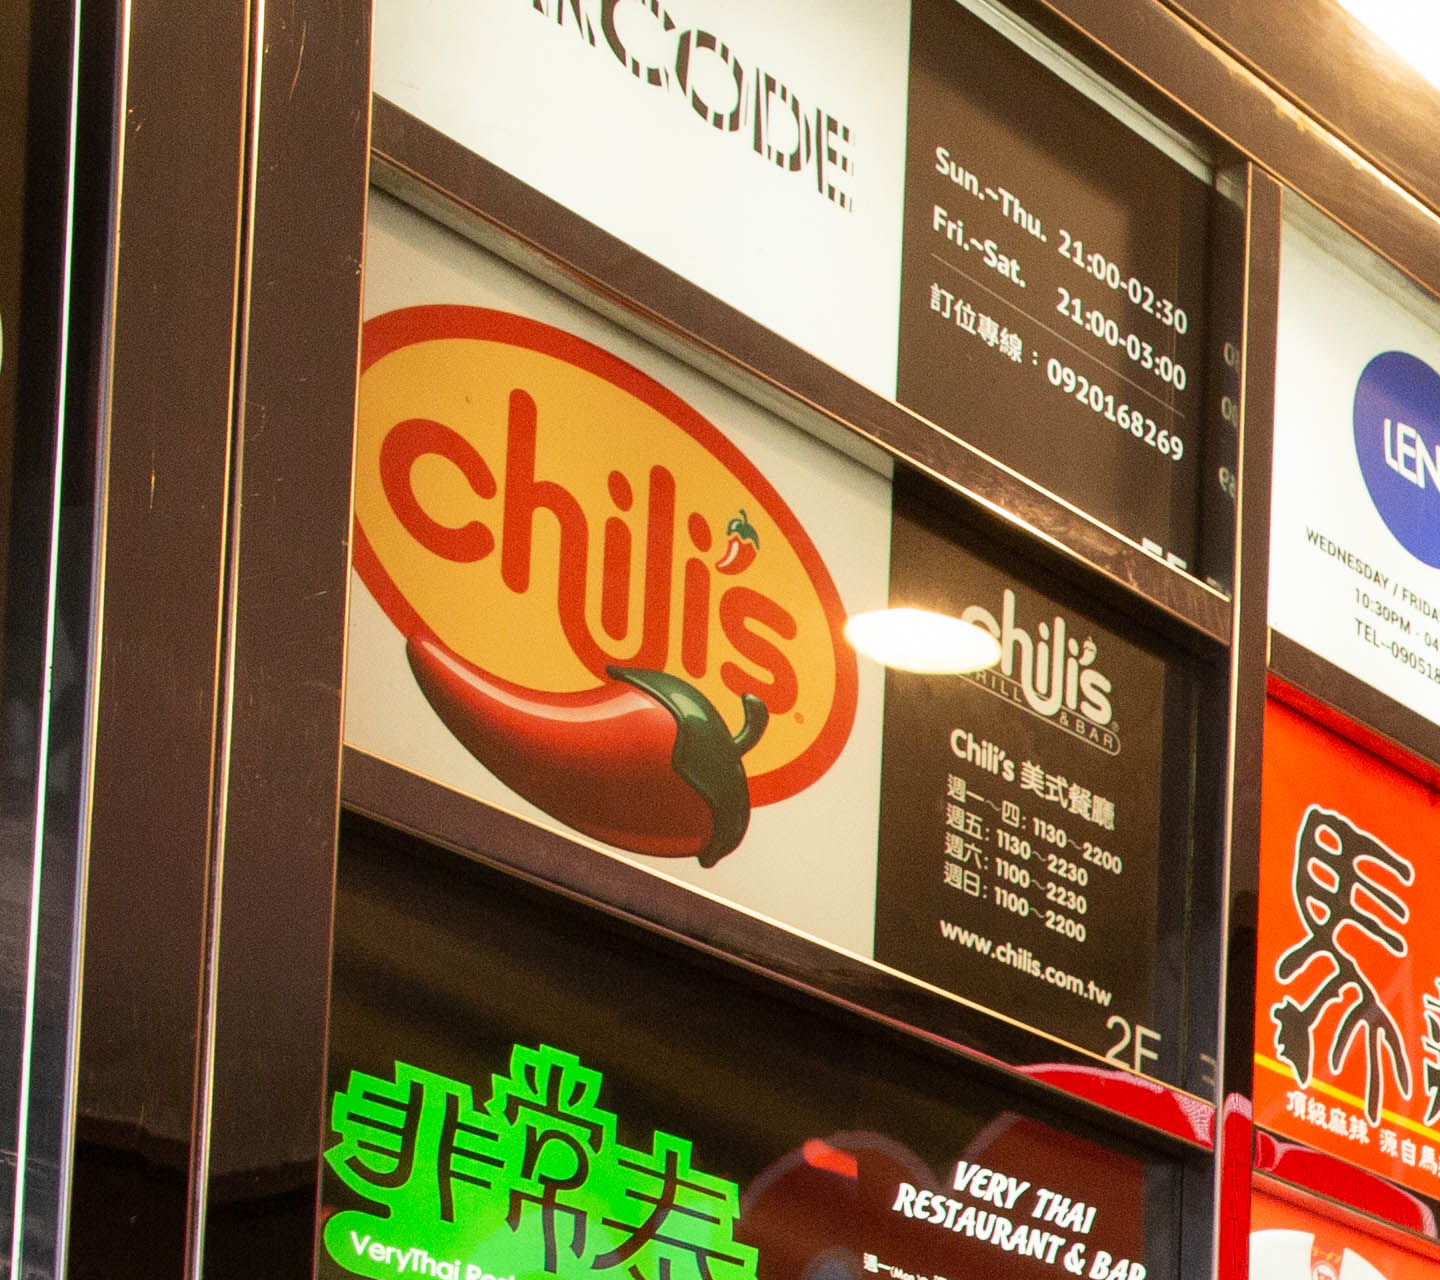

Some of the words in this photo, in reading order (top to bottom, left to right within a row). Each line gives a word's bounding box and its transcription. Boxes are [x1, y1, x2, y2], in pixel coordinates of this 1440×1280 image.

[935, 146, 1047, 242] Sun.~Thu.
[1057, 229, 1188, 334] 21:00-02:30
[933, 204, 1026, 287] Fri.~Sat.
[1056, 288, 1186, 390] 21:00-03:00
[1046, 358, 1183, 461] 0920168269
[379, 388, 799, 716] chili's
[1305, 526, 1388, 592] WEDNESDAY
[1354, 588, 1411, 635] 10:30PM
[1076, 719, 1115, 749] BAR
[949, 728, 1015, 783] Chili's
[1020, 761, 1115, 831] 美式餐廳
[940, 919, 1112, 1007] www.chilis.com.tw
[1106, 1016, 1161, 1072] 2F
[893, 1183, 1066, 1266] RESTAURANT
[1064, 1243, 1088, 1275] &
[953, 1161, 1031, 1212] VERY
[1033, 1189, 1097, 1233] THAI
